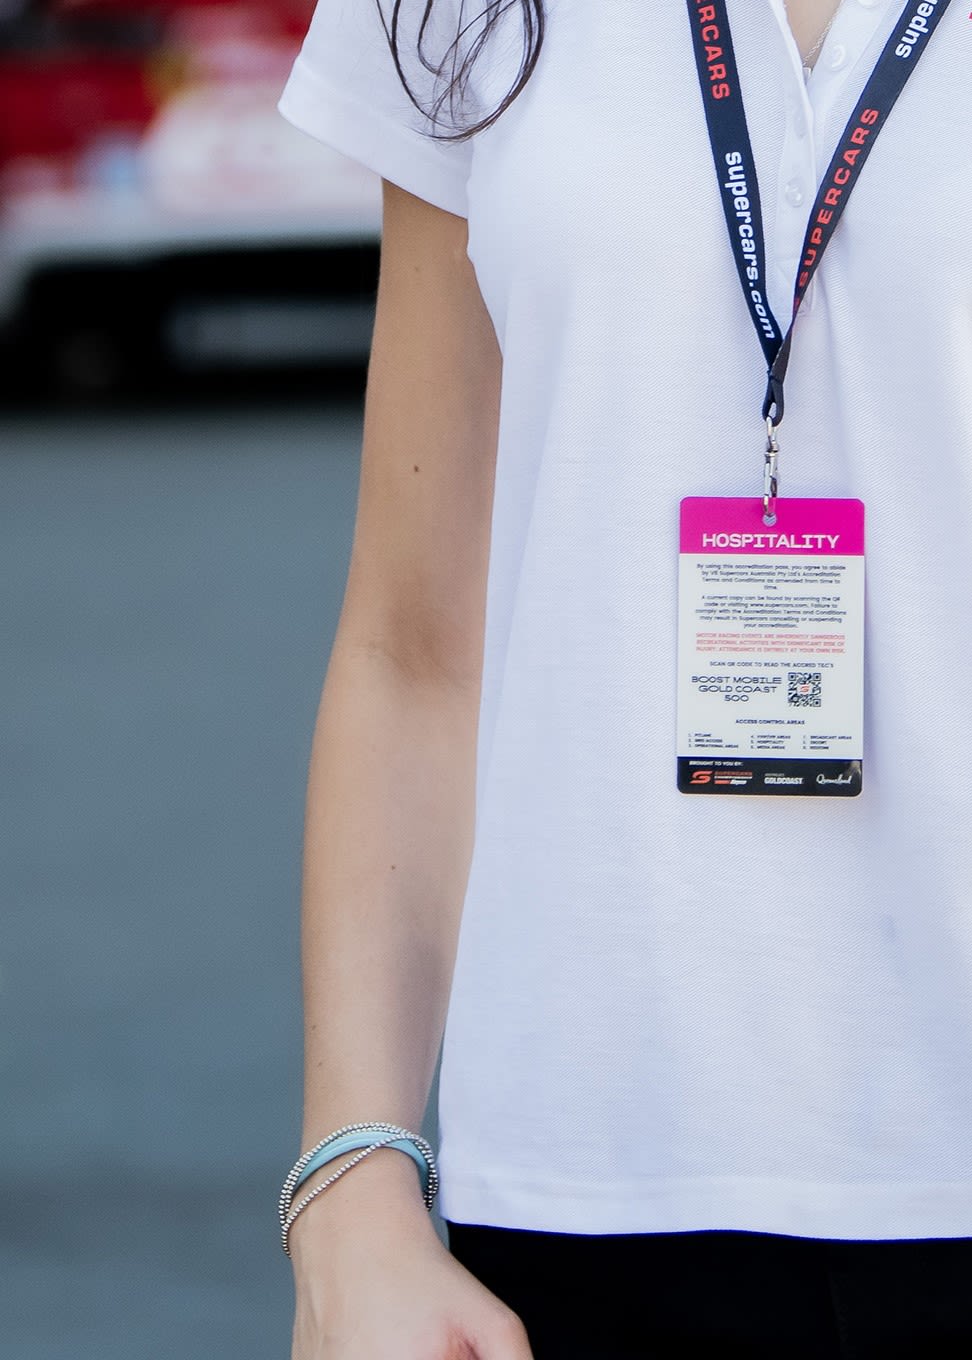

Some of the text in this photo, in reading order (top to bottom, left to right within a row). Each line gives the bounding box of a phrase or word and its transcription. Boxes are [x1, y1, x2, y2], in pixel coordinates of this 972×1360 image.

[799, 108, 880, 287] SUPERCARS
[725, 151, 775, 339] supercars.com
[702, 533, 840, 549] HOSPITALITY
[691, 676, 782, 685] BOOST MOBILE
[698, 685, 733, 693] GOLD
[724, 694, 750, 702] 500
